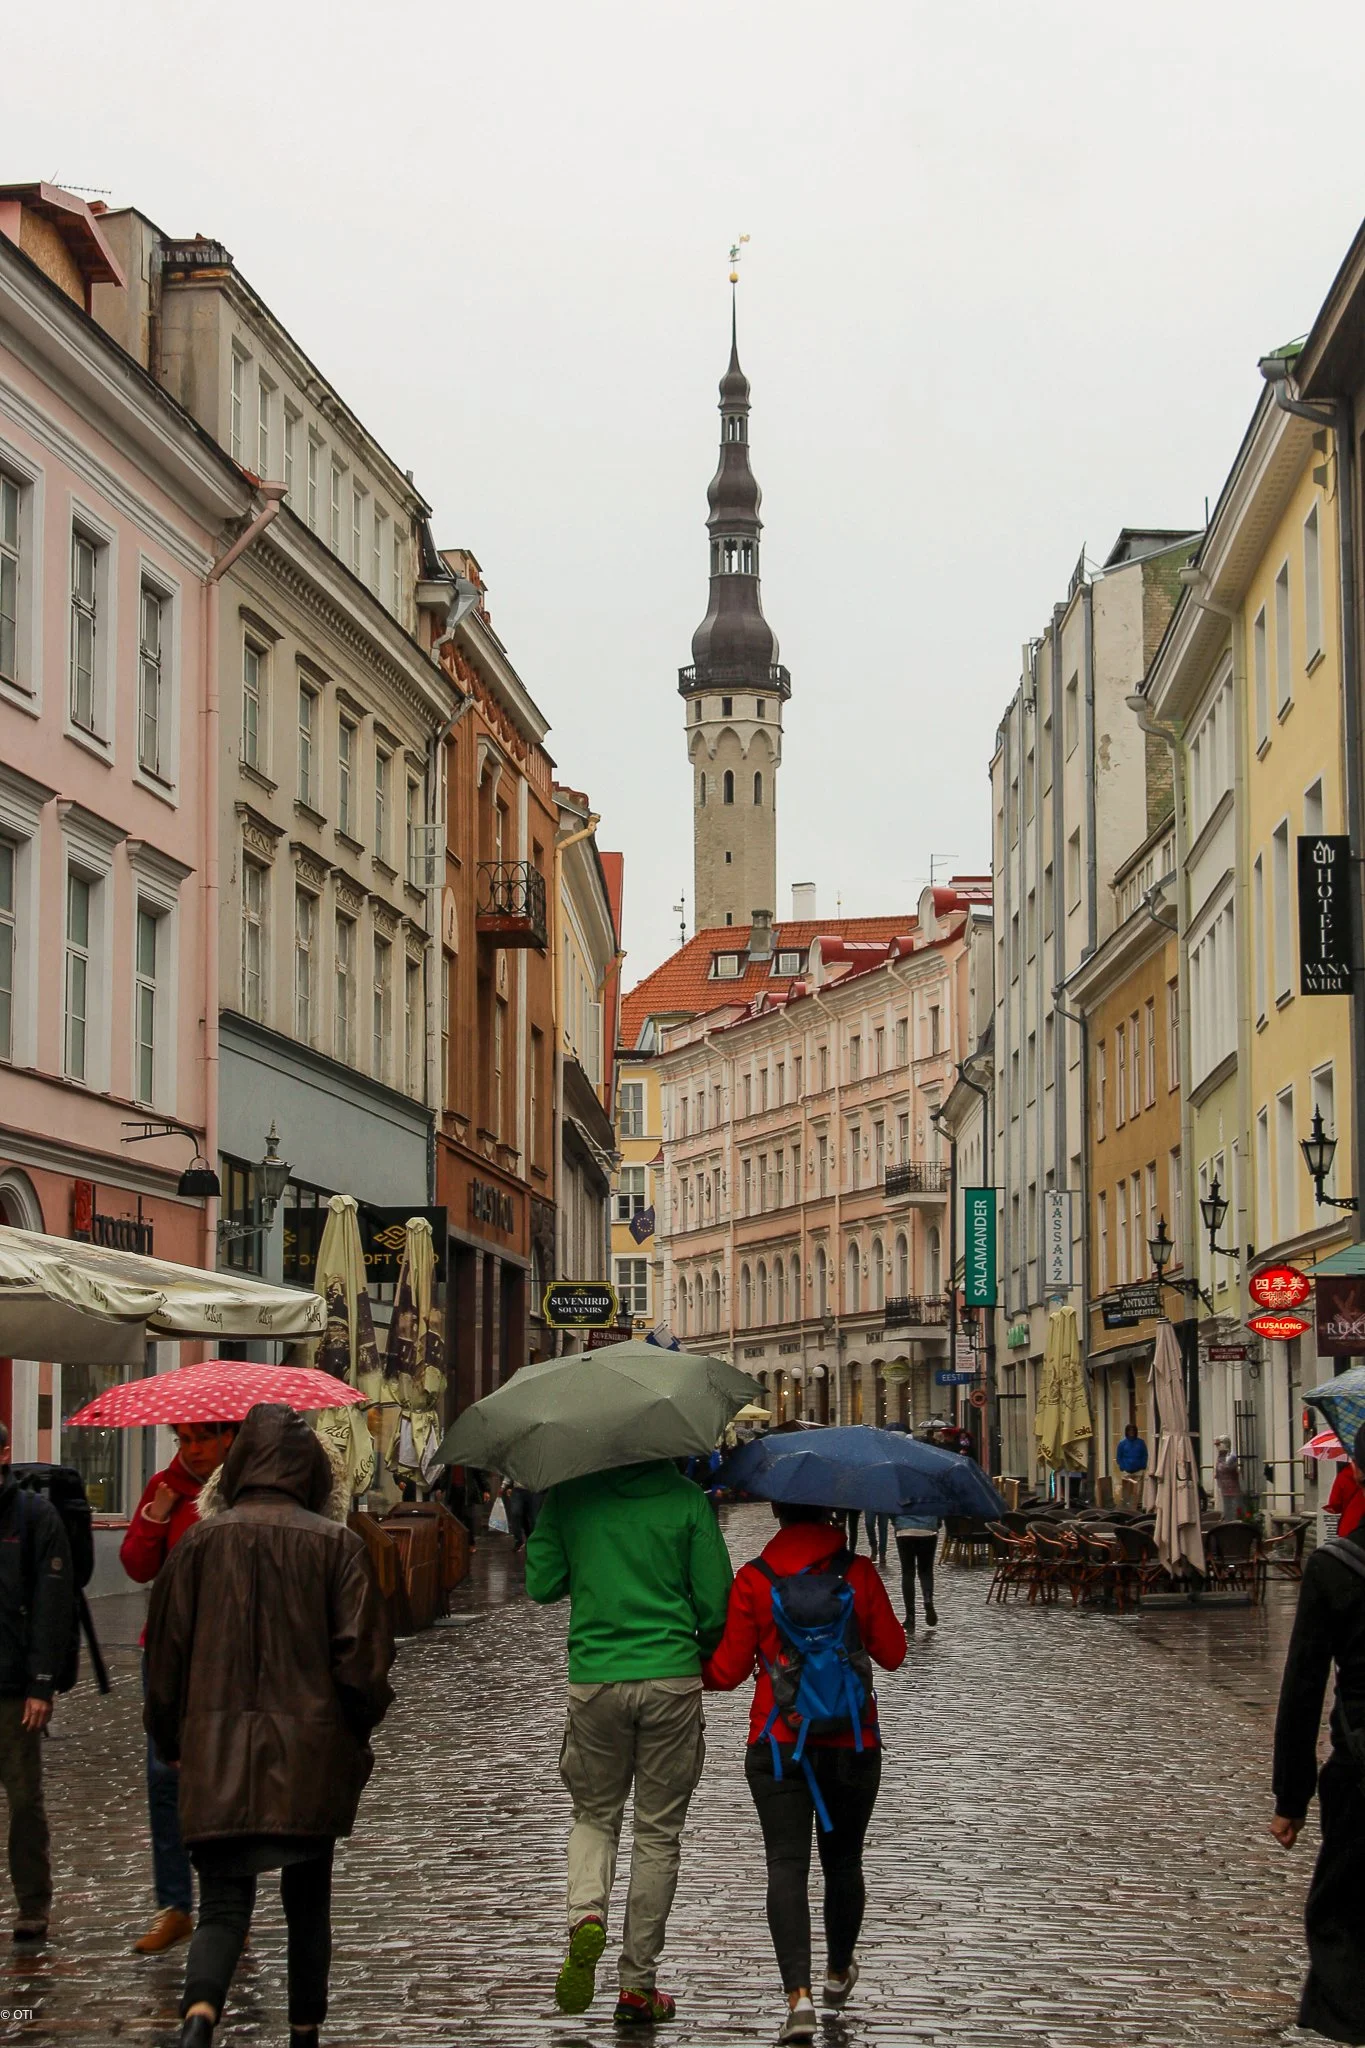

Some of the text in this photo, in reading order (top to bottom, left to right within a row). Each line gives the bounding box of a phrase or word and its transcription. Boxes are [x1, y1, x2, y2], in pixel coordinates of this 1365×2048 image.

[1316, 868, 1334, 959] HOTELL
[1305, 963, 1350, 975] VANA
[1052, 1195, 1063, 1281] MASSAAŽ
[974, 1200, 988, 1296] SALAMANDER
[1259, 1290, 1301, 1301] CHINA
[551, 1297, 609, 1306] SUVENIIRID
[1122, 1296, 1156, 1309] ANTIQUE
[1268, 1298, 1293, 1308] INN
[558, 1306, 602, 1314] SOUVENIRS
[1255, 1321, 1302, 1330] ILUSALONG
[1327, 1322, 1365, 1334] RUK
[942, 1373, 964, 1382] EESTI
